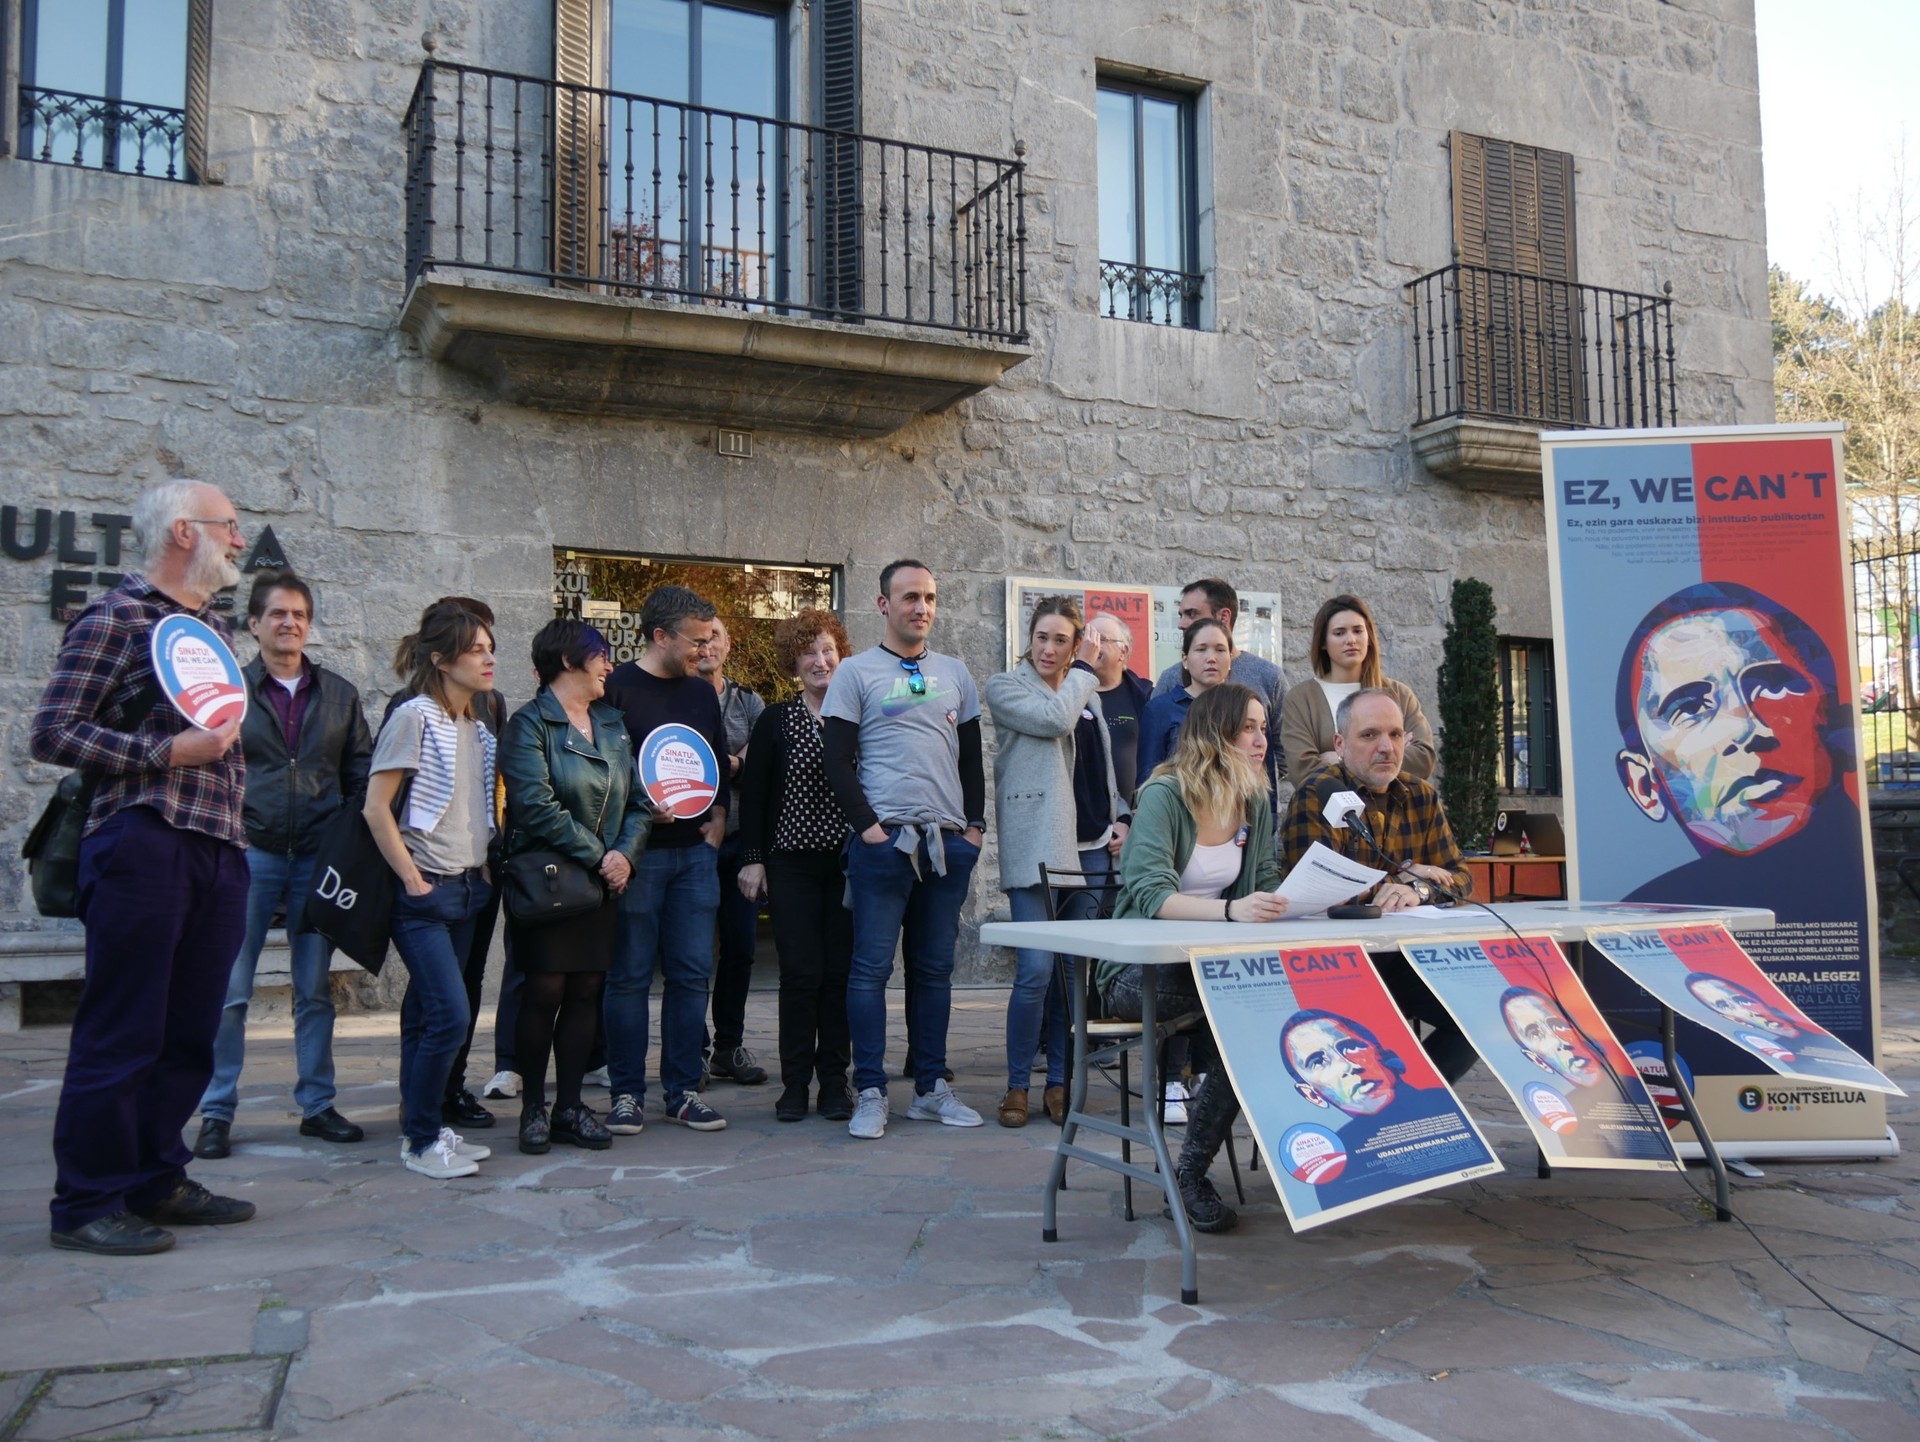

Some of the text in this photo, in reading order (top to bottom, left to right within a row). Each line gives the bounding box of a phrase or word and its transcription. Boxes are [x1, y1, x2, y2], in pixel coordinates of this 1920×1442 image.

[728, 433, 744, 453] 11
[1562, 480, 1621, 509] EZ,
[1630, 477, 1694, 503] WE
[1567, 513, 1825, 528] Ez, ezin gara euskaraz bizi instituzio publikoetan
[177, 646, 210, 657] SINATU!
[664, 748, 695, 759] SINATU!
[684, 758, 700, 766] CAN!
[1597, 938, 1634, 953] EZ,
[1628, 935, 1666, 950] WE
[1411, 949, 1450, 964] EZ,
[1446, 946, 1487, 961] WE
[1200, 959, 1241, 981] EZ,
[1240, 957, 1284, 977] WE
[1813, 971, 1860, 982] LEGEZ!
[1818, 994, 1834, 1004] LA
[1837, 994, 1861, 1004] LEY
[1767, 1091, 1866, 1104] KONTSEILUA
[1377, 1132, 1472, 1159] UDALETAN EUSKARA, LEGEZ!
